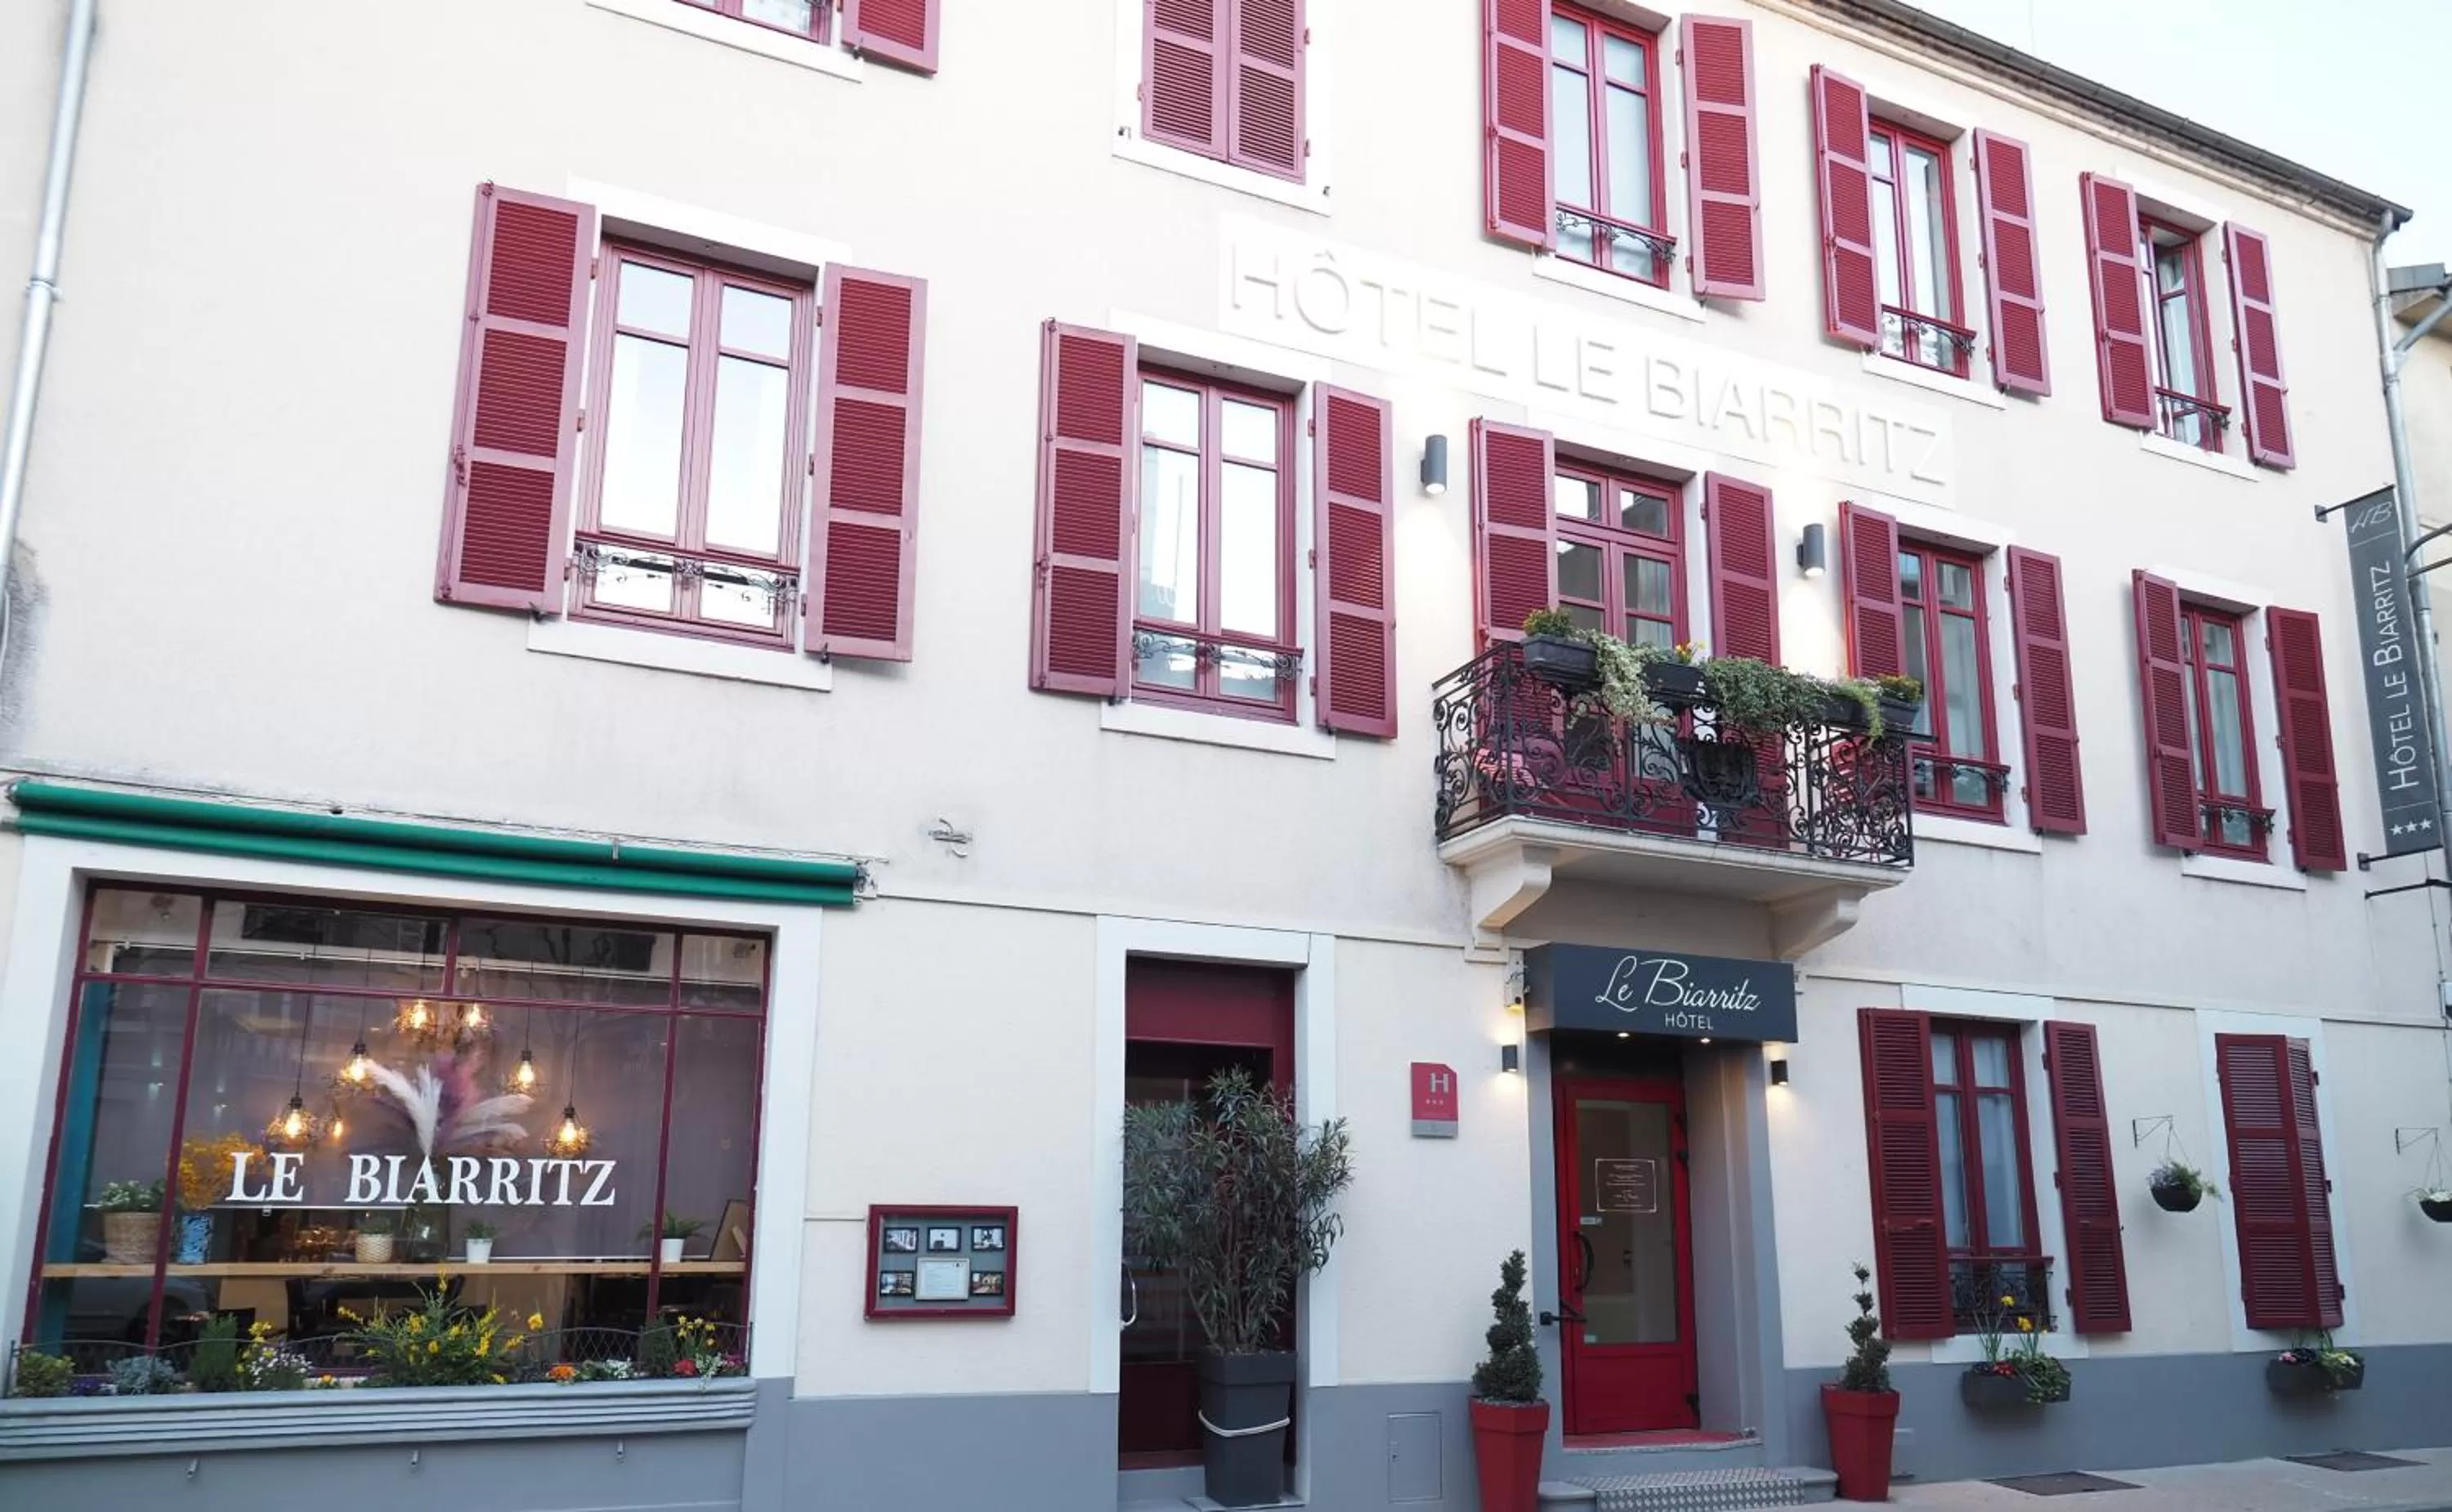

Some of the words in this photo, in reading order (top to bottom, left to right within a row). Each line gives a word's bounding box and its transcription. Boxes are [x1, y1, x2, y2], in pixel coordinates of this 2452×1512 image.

[1229, 237, 1509, 378] HÔTEL
[1530, 317, 1622, 406] LE
[1644, 353, 1948, 488] BIARRITZ
[2386, 671, 2407, 700] LE
[1595, 955, 1638, 1013] Le
[1640, 959, 1761, 1011] Biarritz
[1665, 1012, 1714, 1030] HÔTEL
[1430, 1072, 1449, 1094] H
[225, 1152, 305, 1202] LE
[345, 1154, 616, 1206] BIARRITZ
